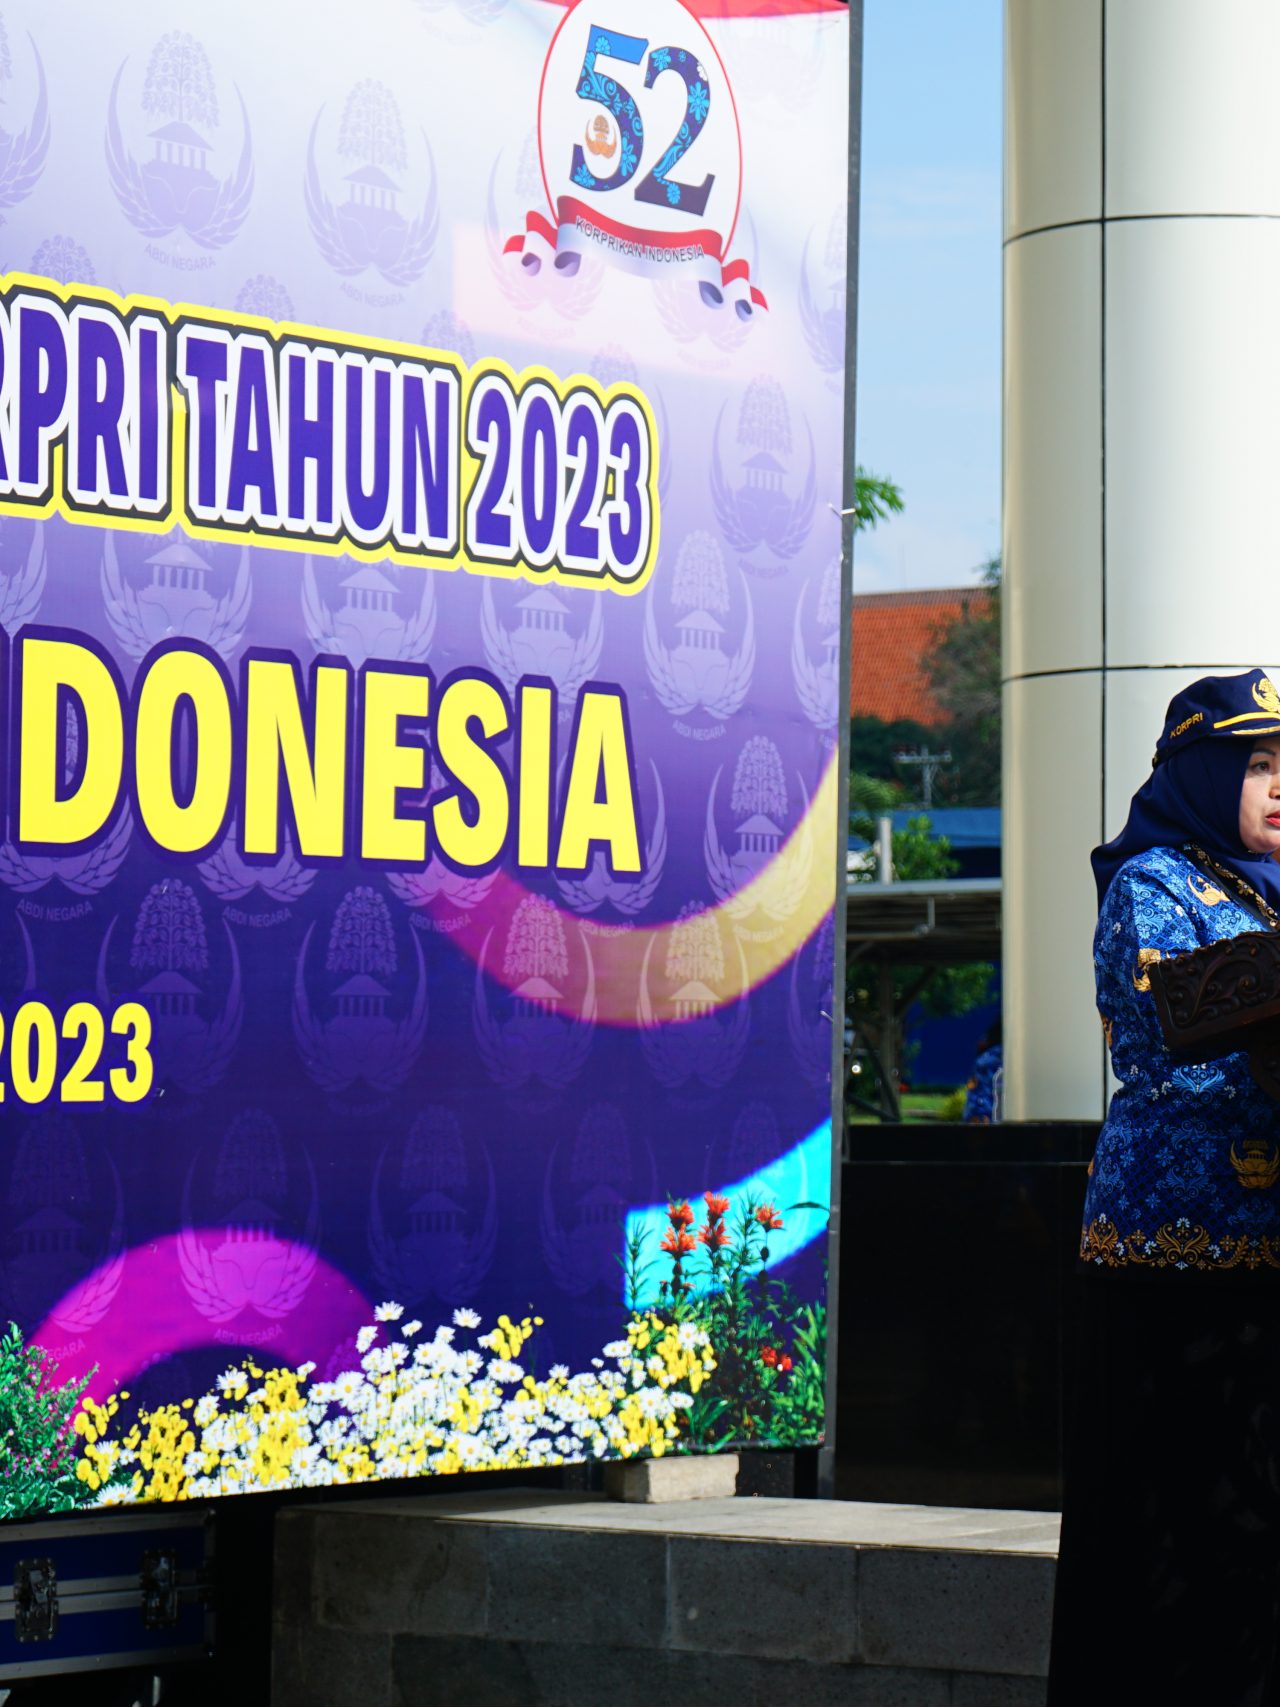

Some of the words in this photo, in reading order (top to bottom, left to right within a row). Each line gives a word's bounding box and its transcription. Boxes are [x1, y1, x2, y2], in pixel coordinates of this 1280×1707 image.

[569, 24, 715, 217] 52
[575, 215, 642, 258] KORPRIKAN
[645, 243, 705, 263] INDONESIA
[0, 302, 162, 507] PRI
[183, 332, 454, 545] TAHUN
[472, 386, 645, 568] 2023
[1170, 711, 1204, 739] KORPRI
[16, 898, 44, 919] ABDI
[47, 900, 94, 921] NEGARA
[222, 905, 248, 926] ABDI
[250, 907, 293, 928] NEGARA
[0, 1001, 154, 1104] 023
